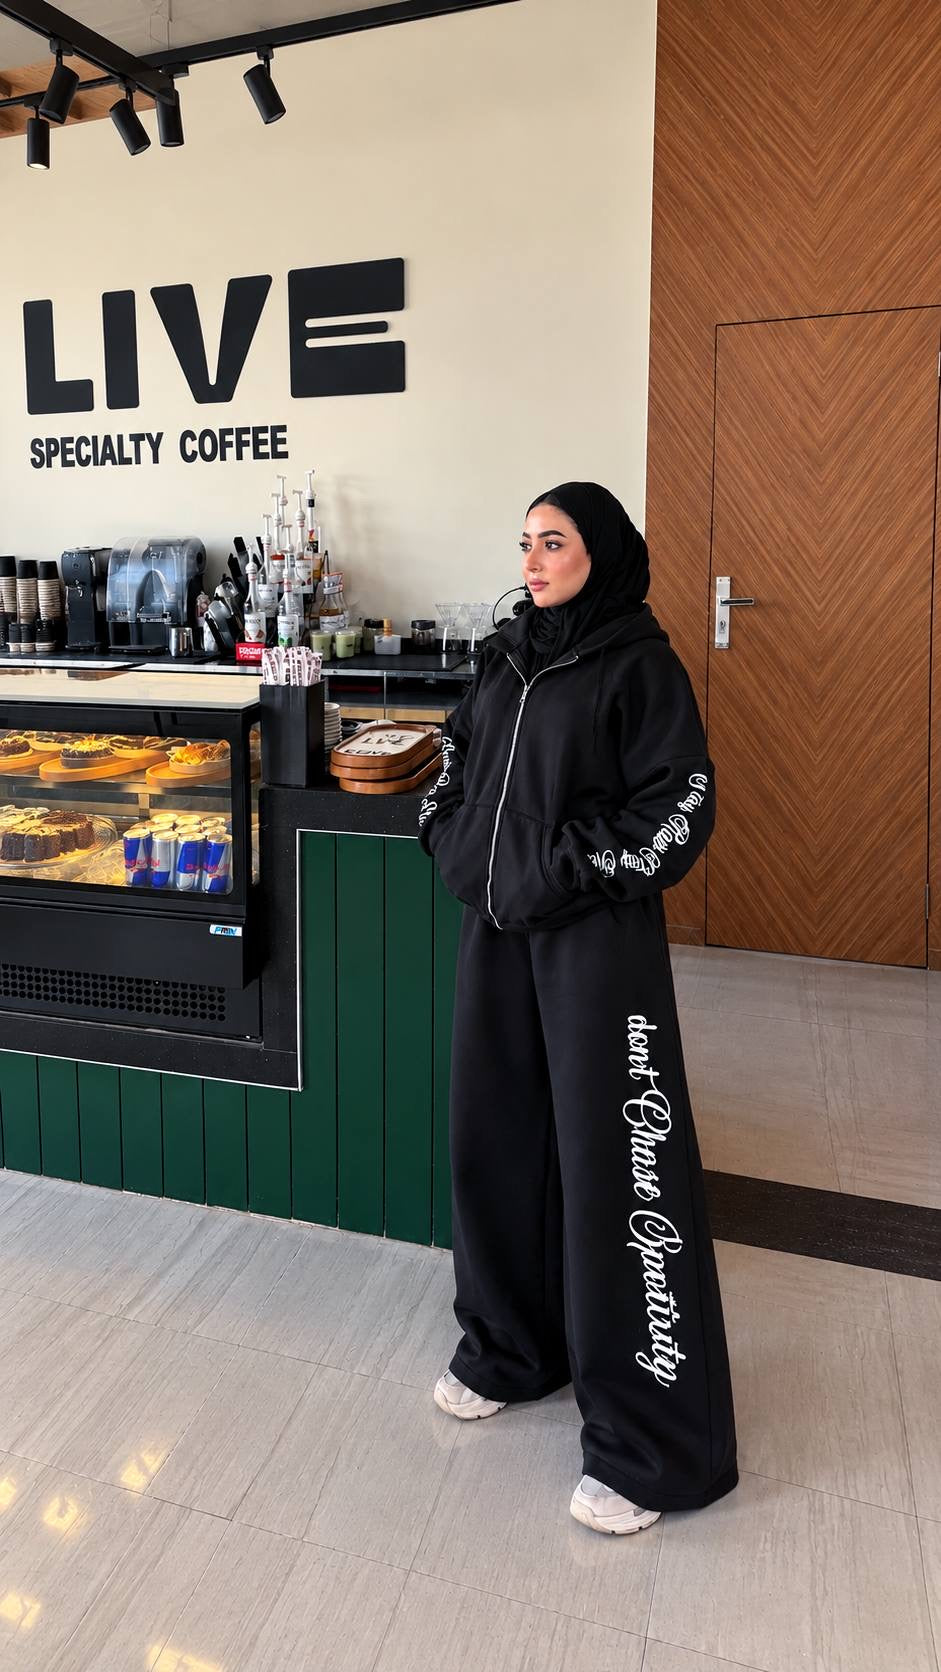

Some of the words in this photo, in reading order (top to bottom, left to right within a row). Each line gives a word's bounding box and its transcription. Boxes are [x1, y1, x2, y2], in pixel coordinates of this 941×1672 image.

[23, 257, 406, 415] LIVE
[30, 432, 164, 469] SPECIALTY
[179, 424, 289, 463] COFFEE
[622, 1088, 673, 1202] Chase
